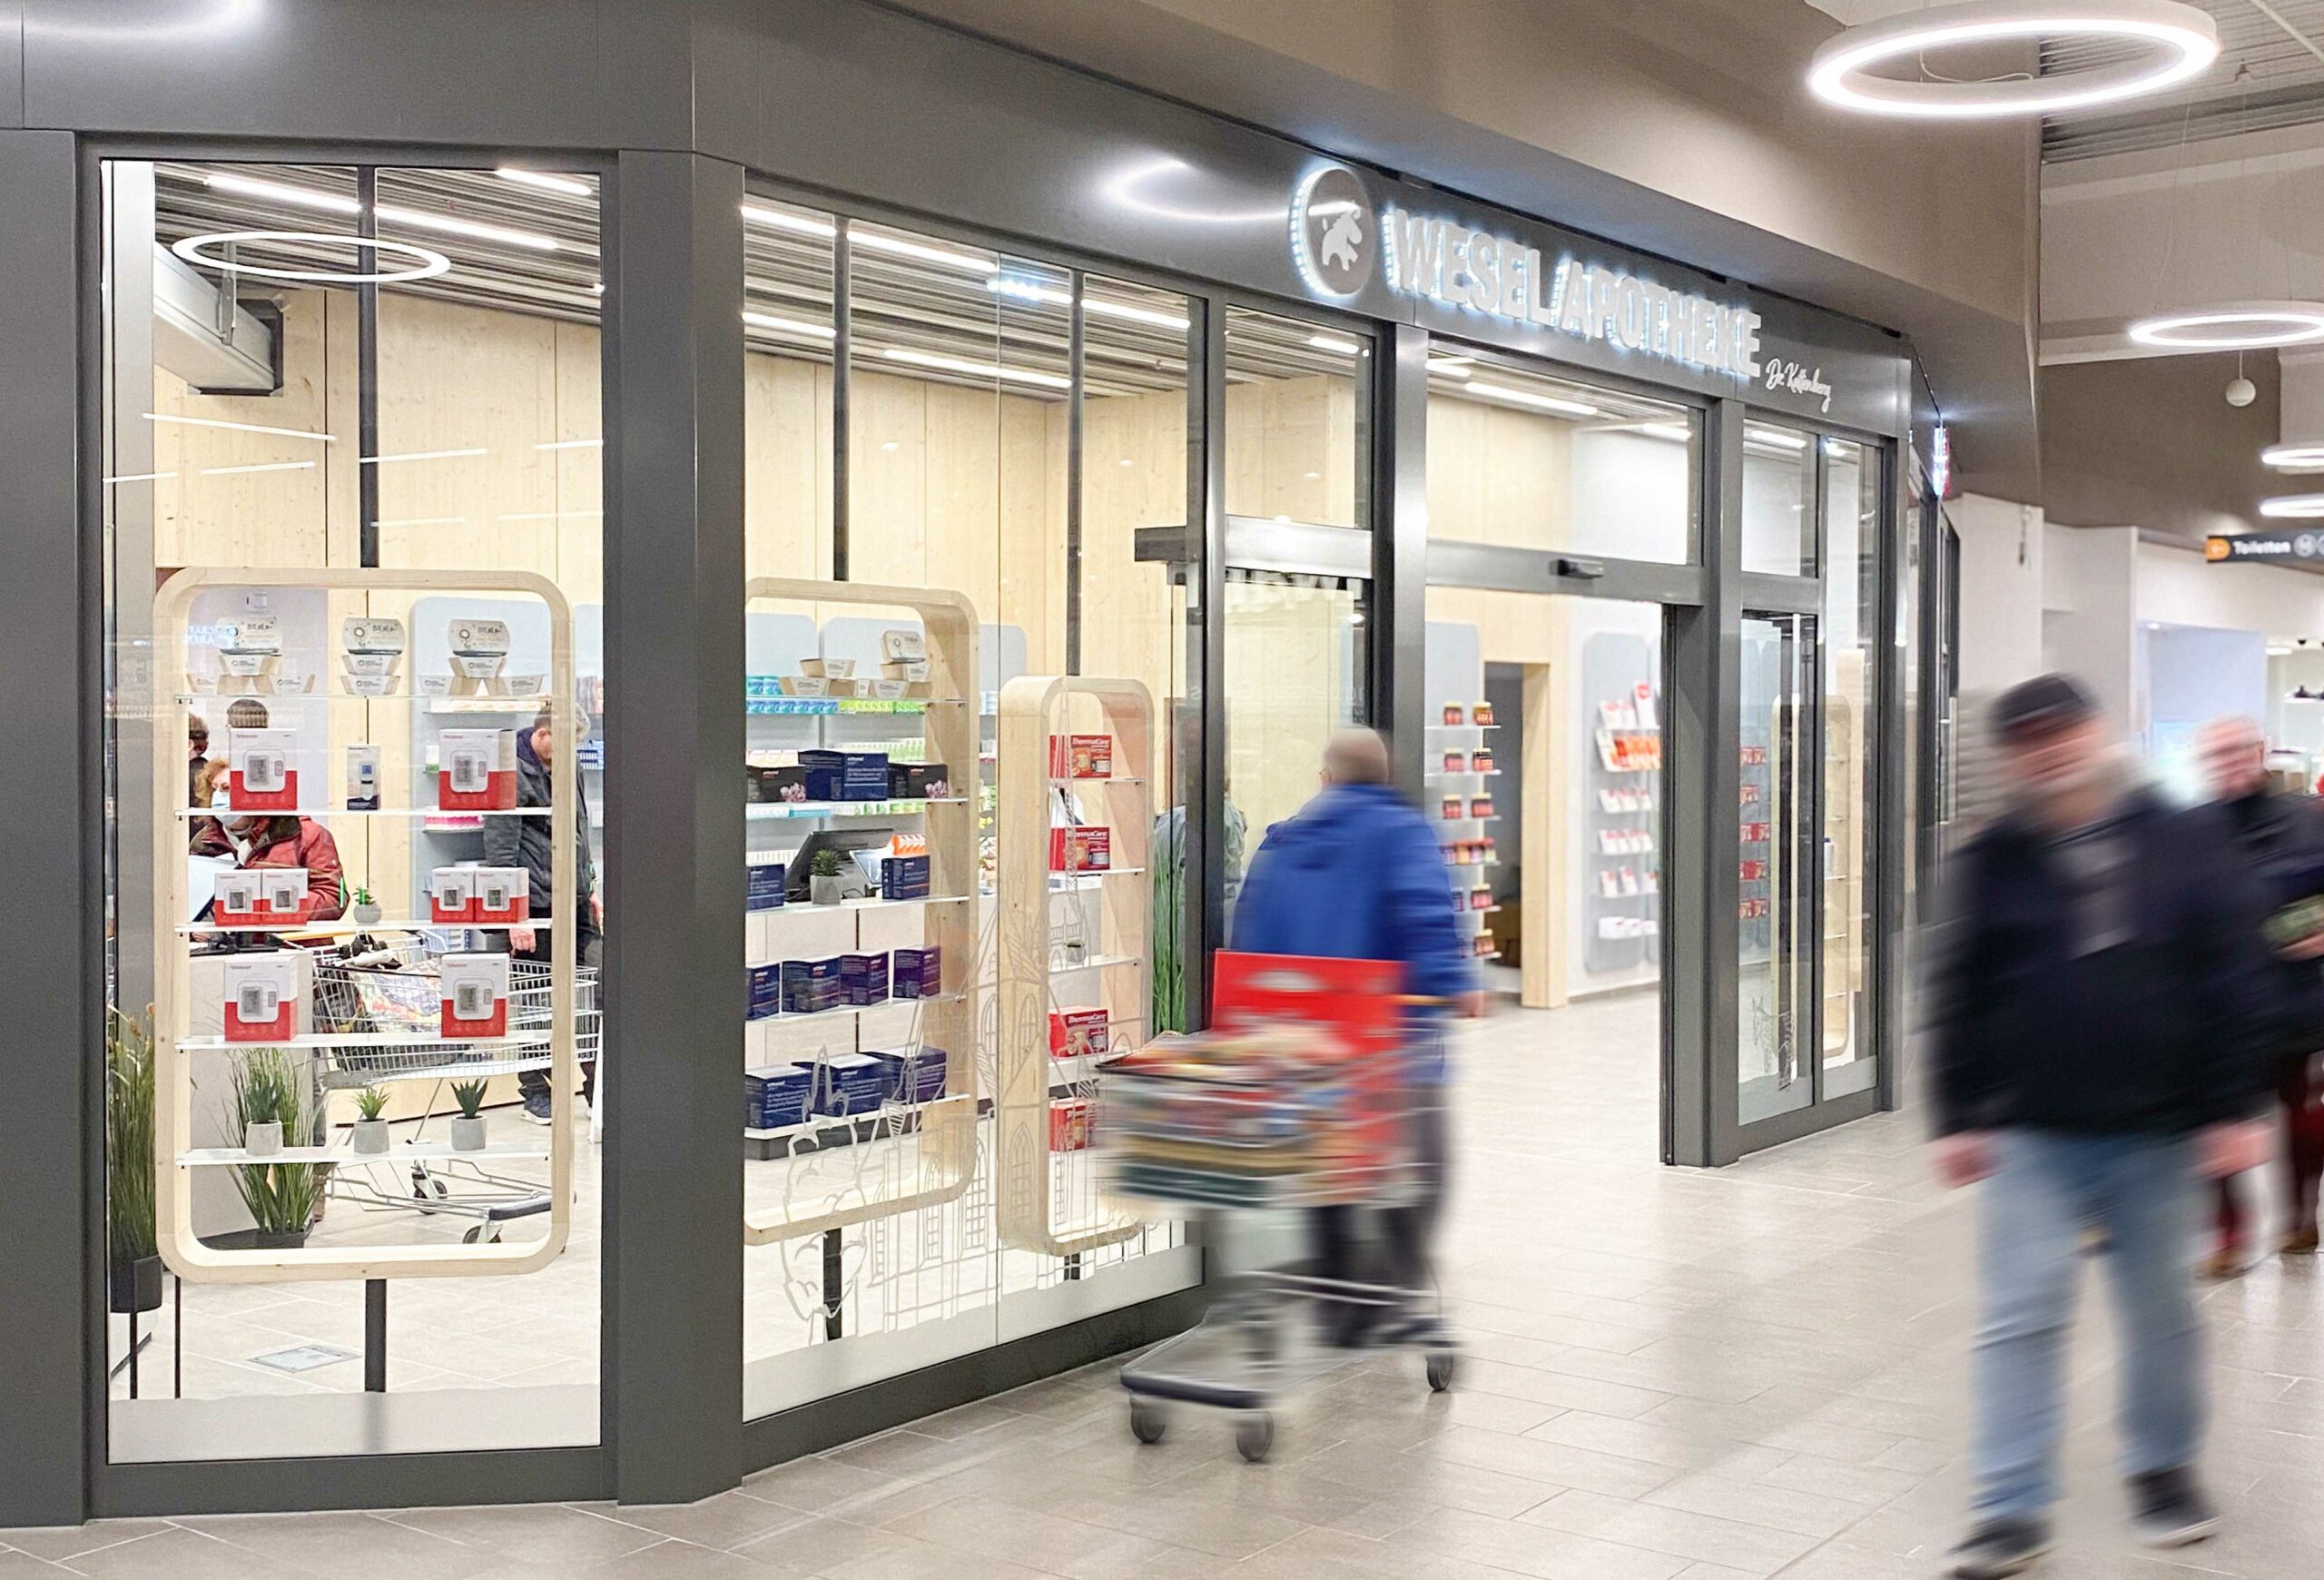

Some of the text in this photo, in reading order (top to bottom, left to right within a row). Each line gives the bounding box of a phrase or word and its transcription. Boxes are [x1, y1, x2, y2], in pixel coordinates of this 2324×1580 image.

[1384, 209, 1761, 378] WESEL APOTHEKE
[1765, 358, 1786, 390] Dr.
[2232, 540, 2291, 555] Toiletten
